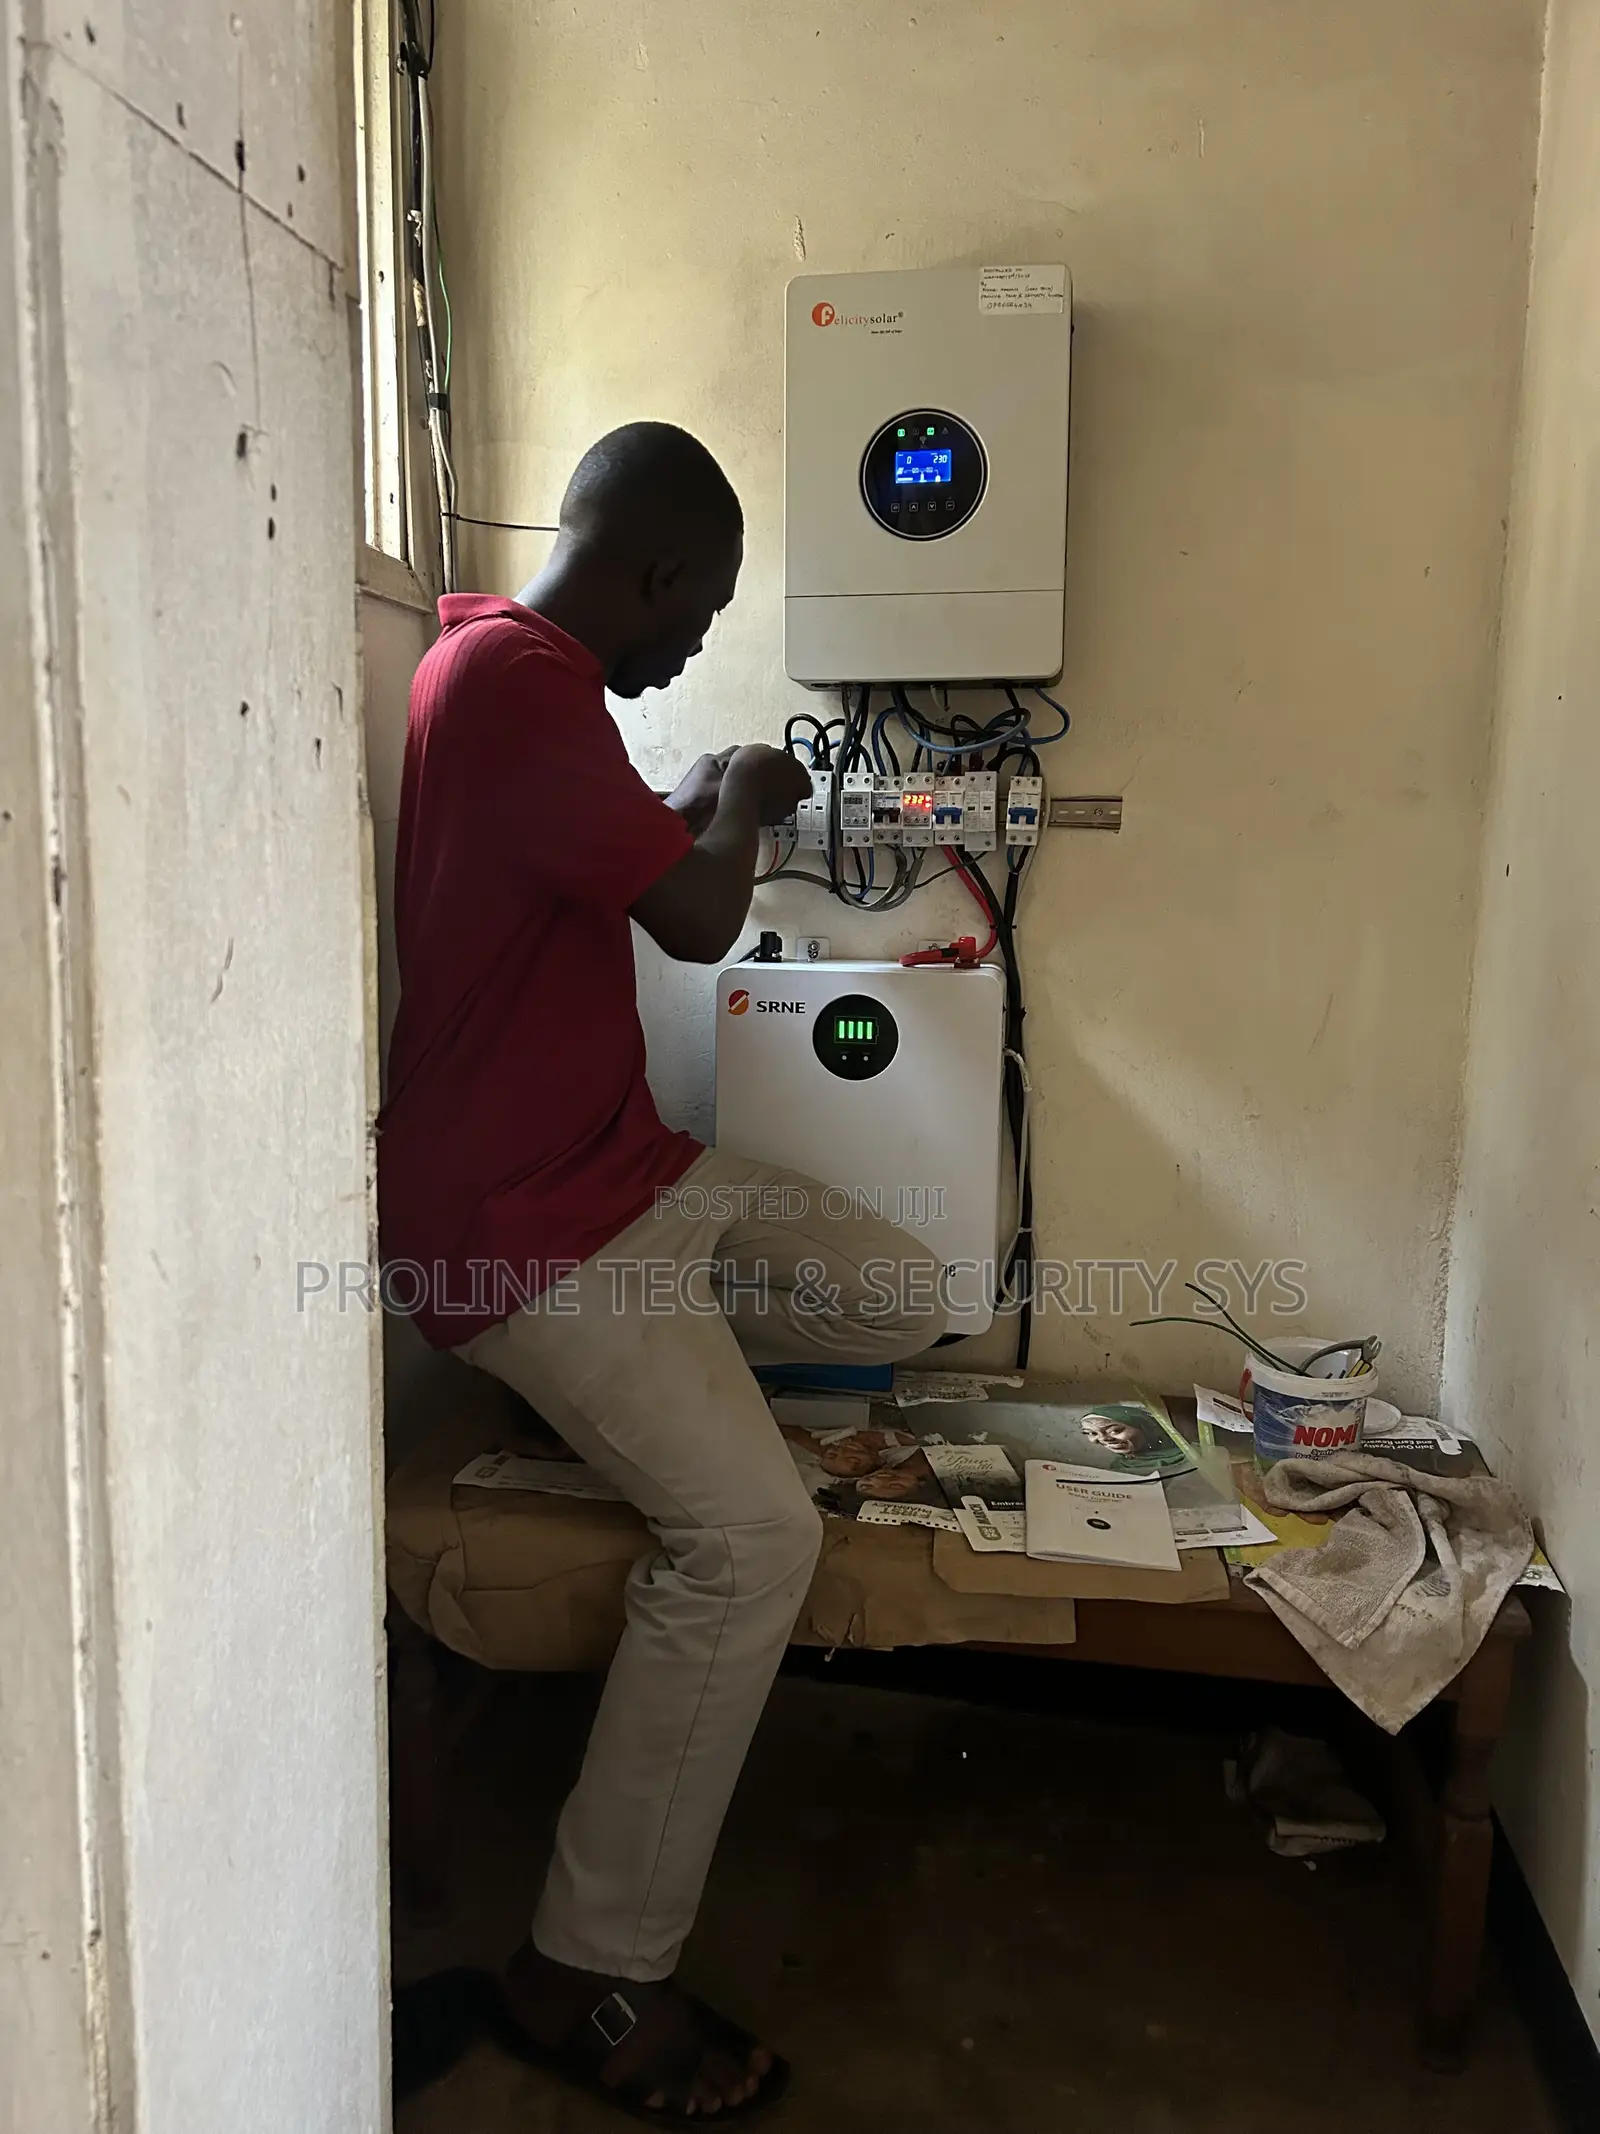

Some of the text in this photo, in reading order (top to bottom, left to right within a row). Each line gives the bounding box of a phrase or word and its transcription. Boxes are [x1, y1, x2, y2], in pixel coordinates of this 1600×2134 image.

[933, 455, 949, 464] 230
[904, 794, 925, 805] 232
[756, 1000, 806, 1013] SRNE
[1292, 1423, 1359, 1447] NOMI
[1056, 1483, 1133, 1499] USER GUIDE
